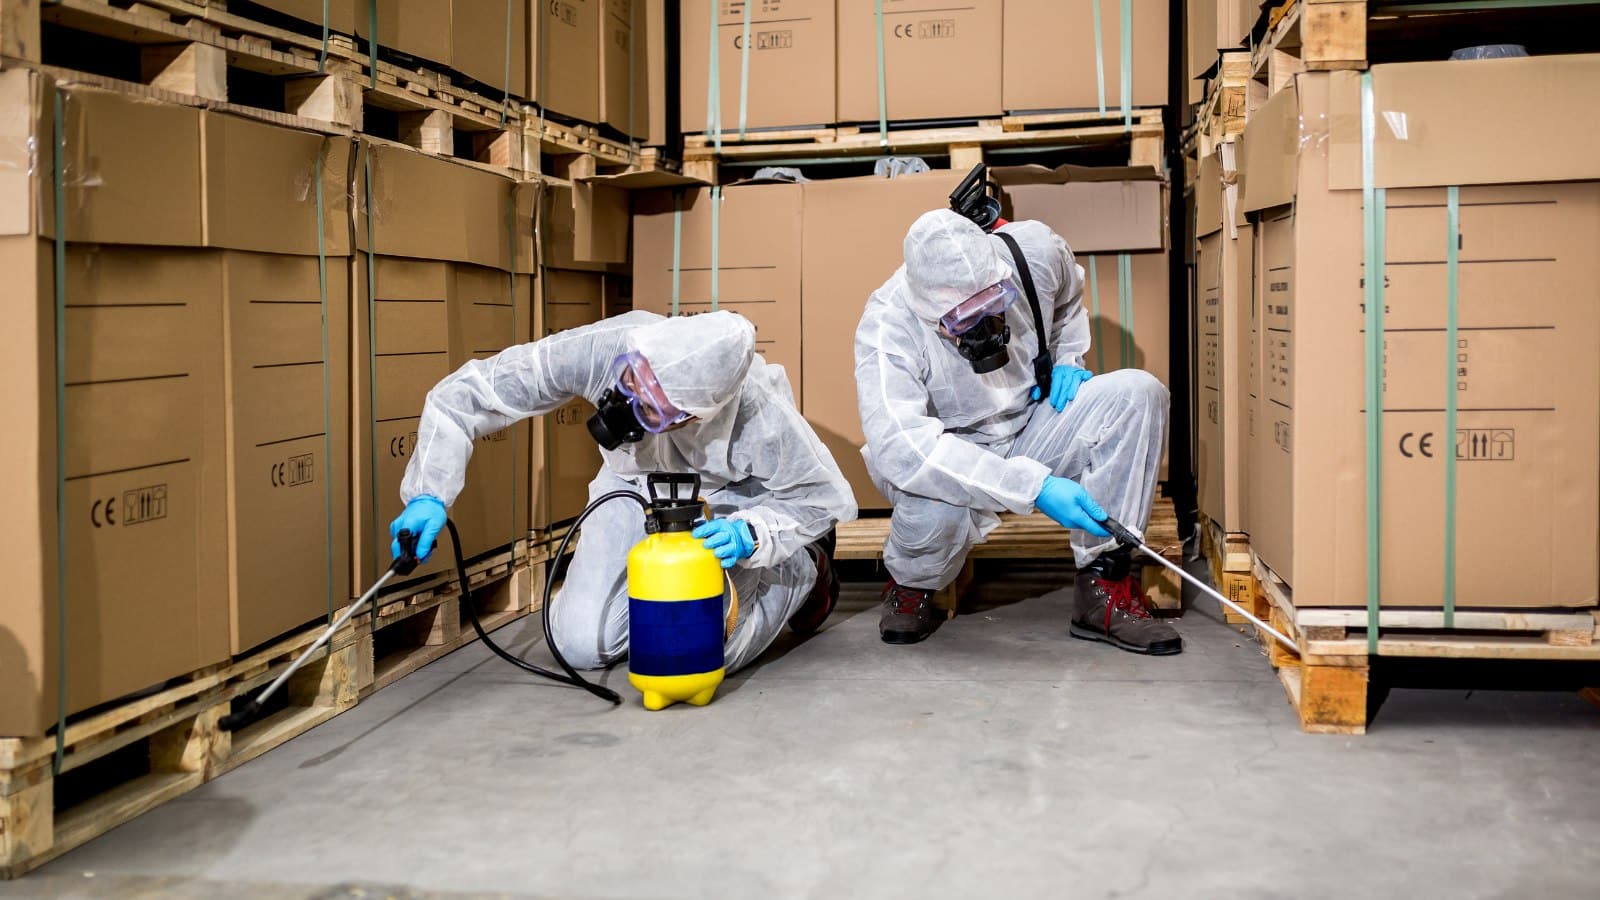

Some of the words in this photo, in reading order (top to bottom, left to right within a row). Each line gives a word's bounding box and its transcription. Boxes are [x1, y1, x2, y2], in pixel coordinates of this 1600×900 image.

[895, 24, 912, 38] CE
[391, 436, 404, 458] CE
[1400, 433, 1433, 457] CE
[271, 462, 285, 487] CE
[91, 497, 115, 528] CE
